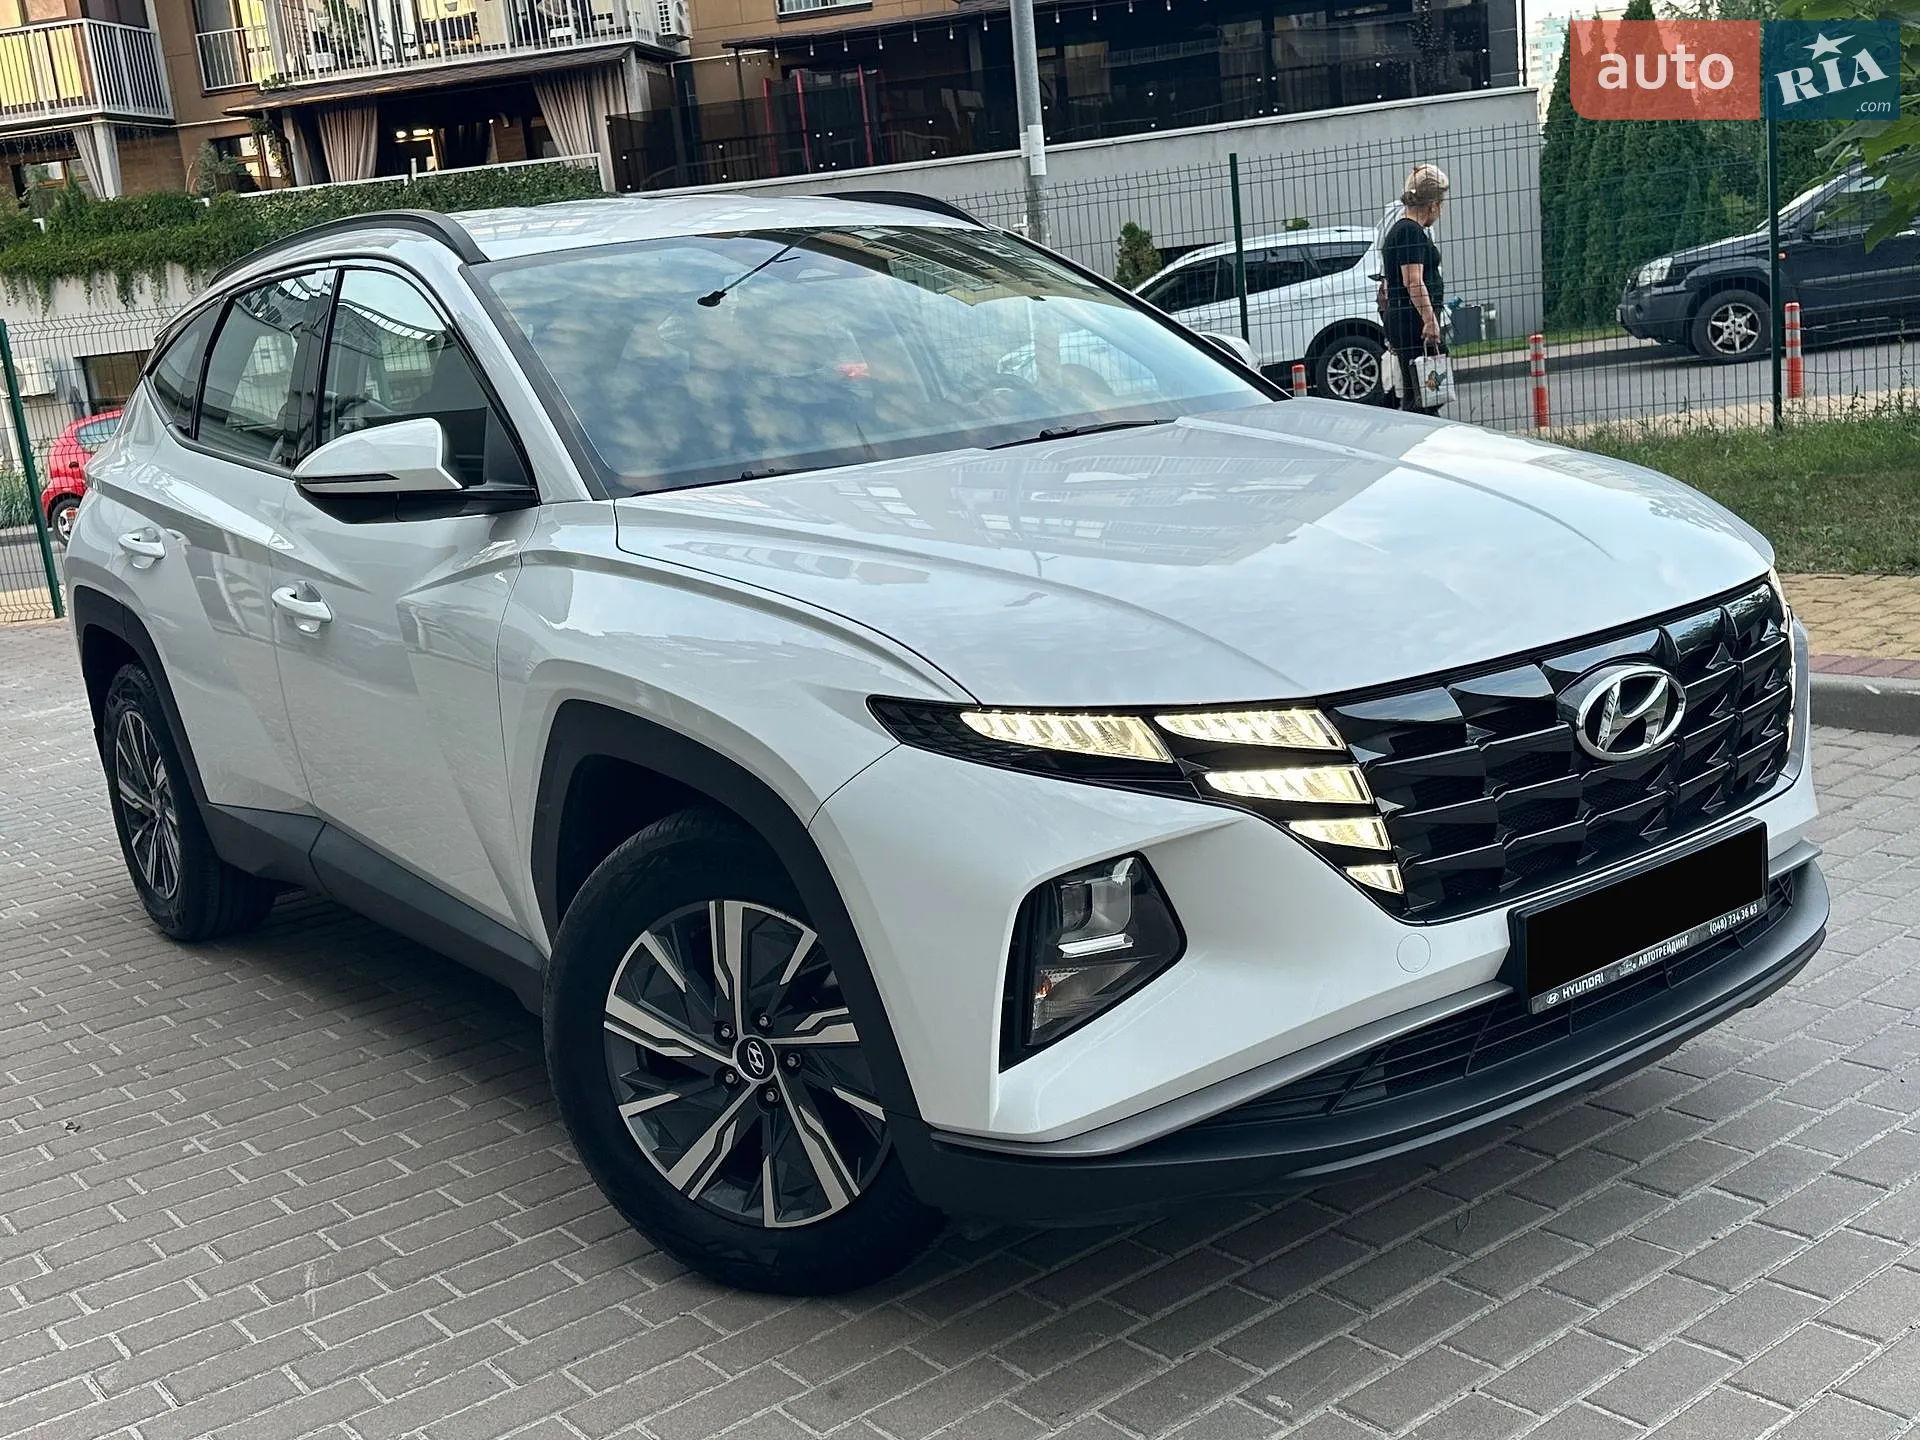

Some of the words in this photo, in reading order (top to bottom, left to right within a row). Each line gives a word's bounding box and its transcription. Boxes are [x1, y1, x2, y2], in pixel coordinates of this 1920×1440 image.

[1709, 916, 1727, 936] (048)
[1638, 935, 1689, 967] АВТОТРЕЙДИНГ
[1562, 972, 1604, 999] HYUNDAI
